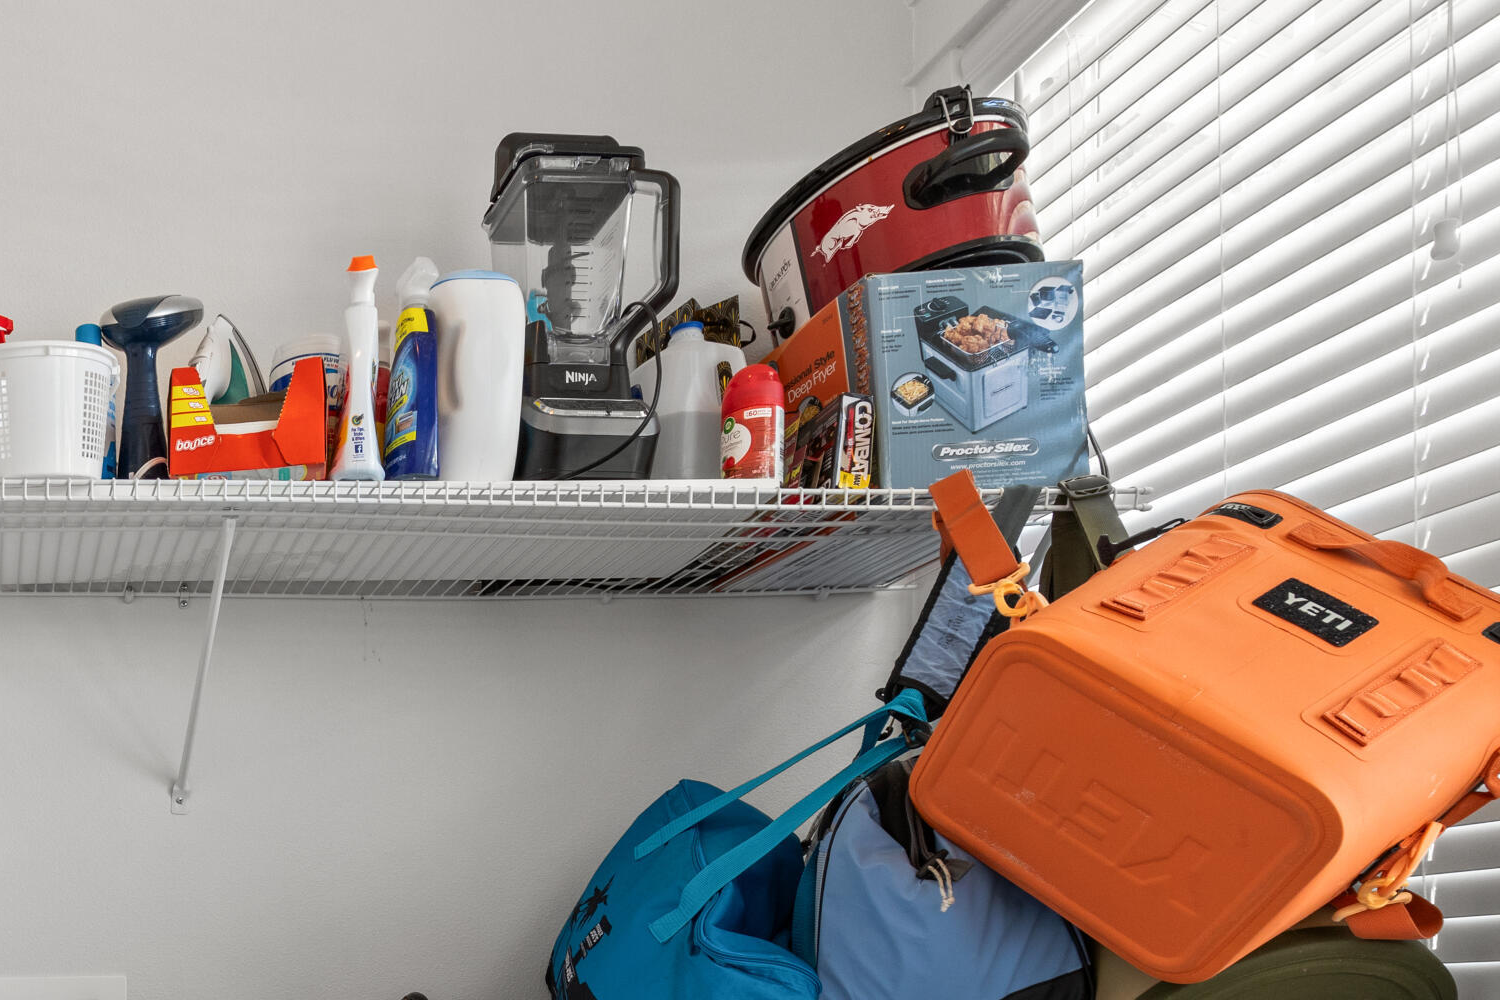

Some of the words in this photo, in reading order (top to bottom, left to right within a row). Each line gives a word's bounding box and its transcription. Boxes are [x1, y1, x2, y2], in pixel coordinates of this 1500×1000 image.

[813, 350, 836, 369] Style
[565, 370, 598, 386] NINJA
[788, 379, 813, 403] Deep
[812, 361, 837, 384] Fryer
[175, 434, 216, 452] bounce
[851, 401, 872, 481] COMBAT
[939, 445, 994, 457] Proctor
[994, 443, 1030, 453] Silex
[950, 459, 1026, 470] www.proctorsilex.com
[1284, 591, 1354, 631] YETI
